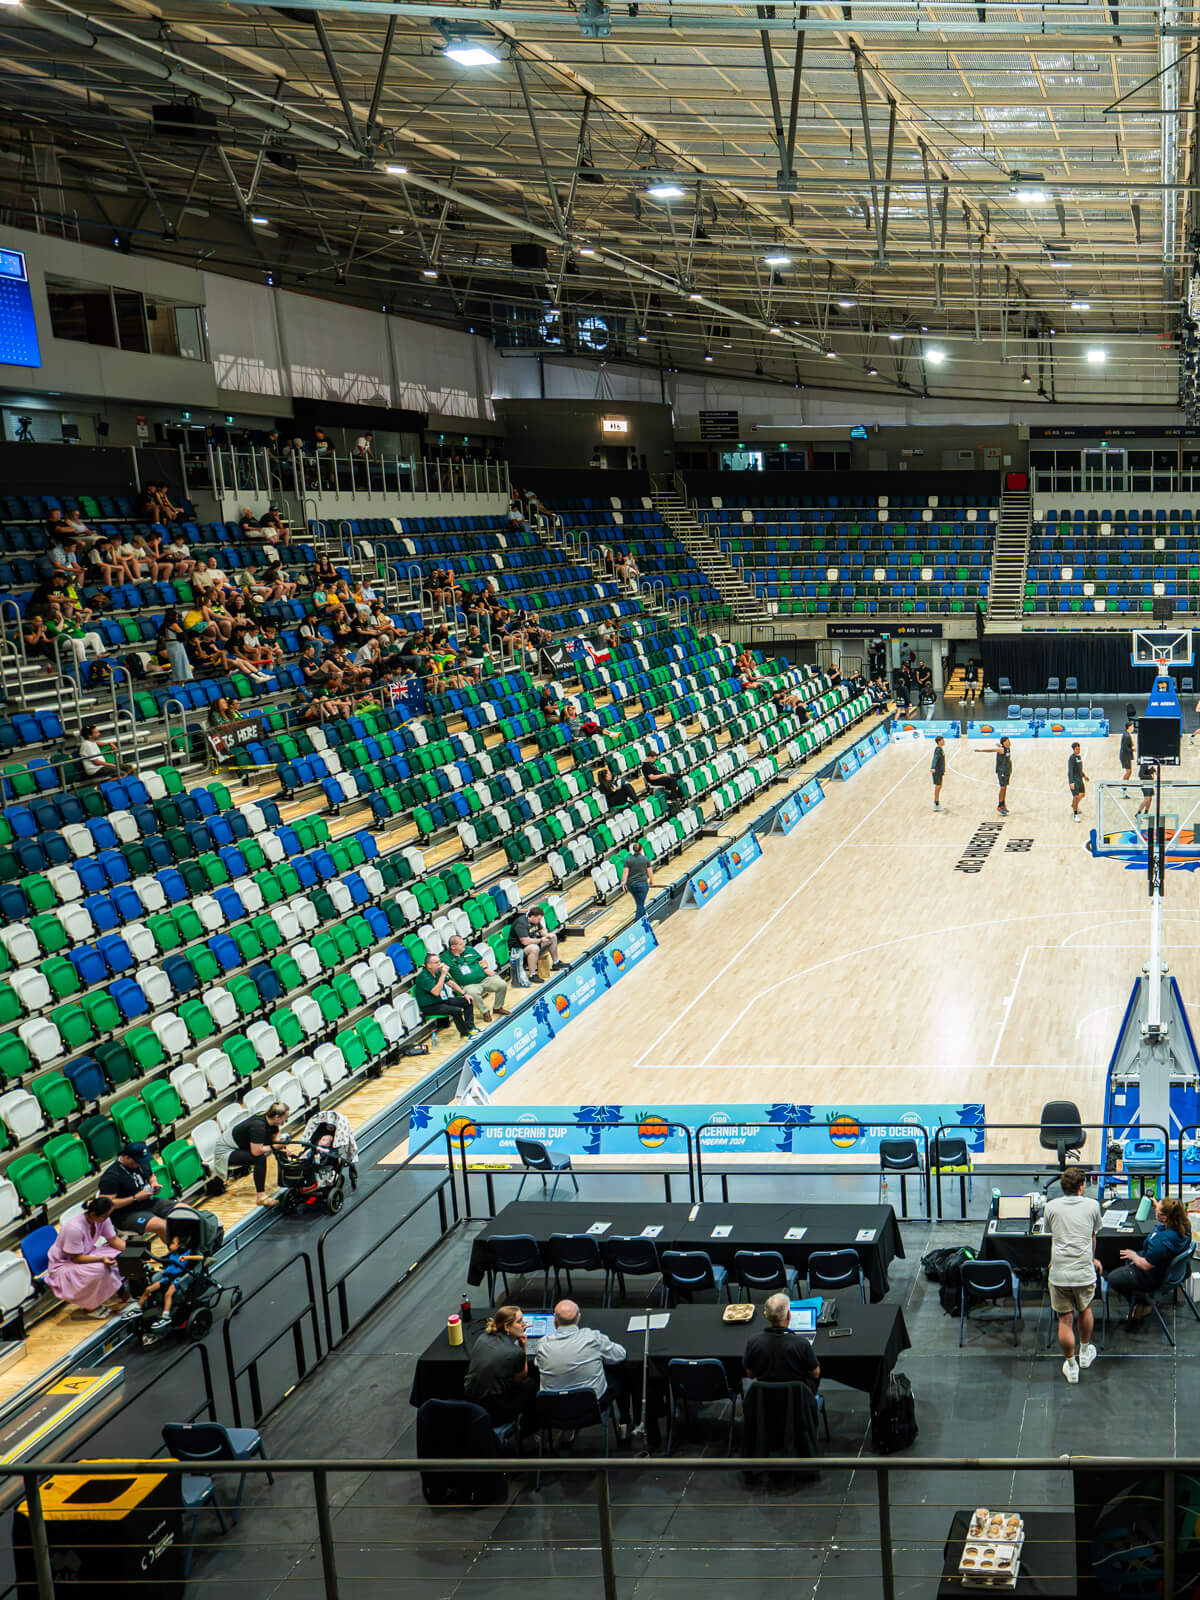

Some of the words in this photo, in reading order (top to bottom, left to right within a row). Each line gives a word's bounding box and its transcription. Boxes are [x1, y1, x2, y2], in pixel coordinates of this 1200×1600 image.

[237, 724, 258, 743] HERE
[486, 1127, 503, 1138] U15
[505, 1127, 546, 1139] OCEANIA
[547, 1127, 568, 1139] CUP
[678, 1126, 696, 1137] U5
[741, 1126, 760, 1137] CUP
[869, 1126, 886, 1137] U15
